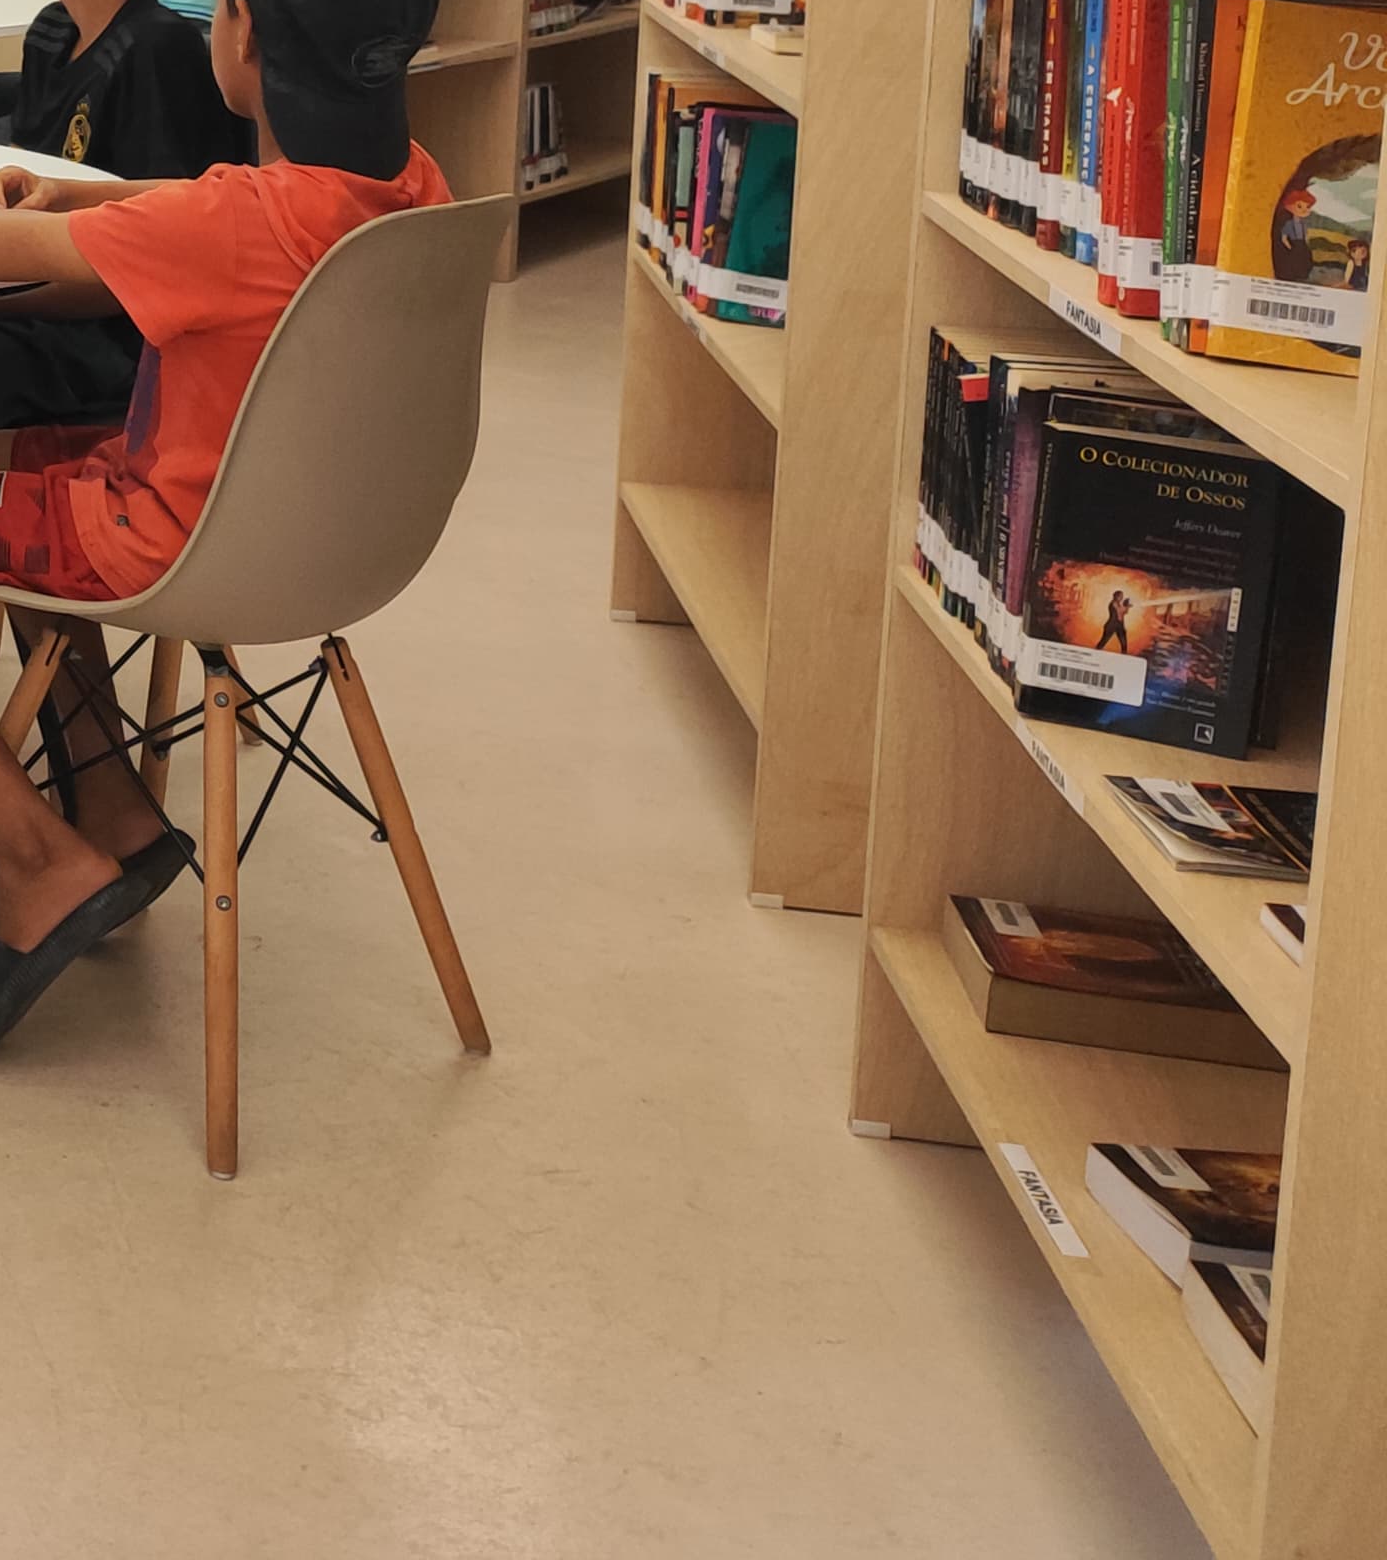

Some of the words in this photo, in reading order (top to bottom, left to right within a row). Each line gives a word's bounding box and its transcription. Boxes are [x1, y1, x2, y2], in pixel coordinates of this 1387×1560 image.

[1041, 92, 1052, 166] CHAMAS
[1065, 300, 1102, 337] FANTASIA
[1079, 446, 1098, 463] O
[1102, 450, 1249, 489] COLECIONADOR
[1157, 483, 1181, 500] DE
[1185, 486, 1246, 511] OSSOS
[1018, 1168, 1063, 1227] FANTASIA
